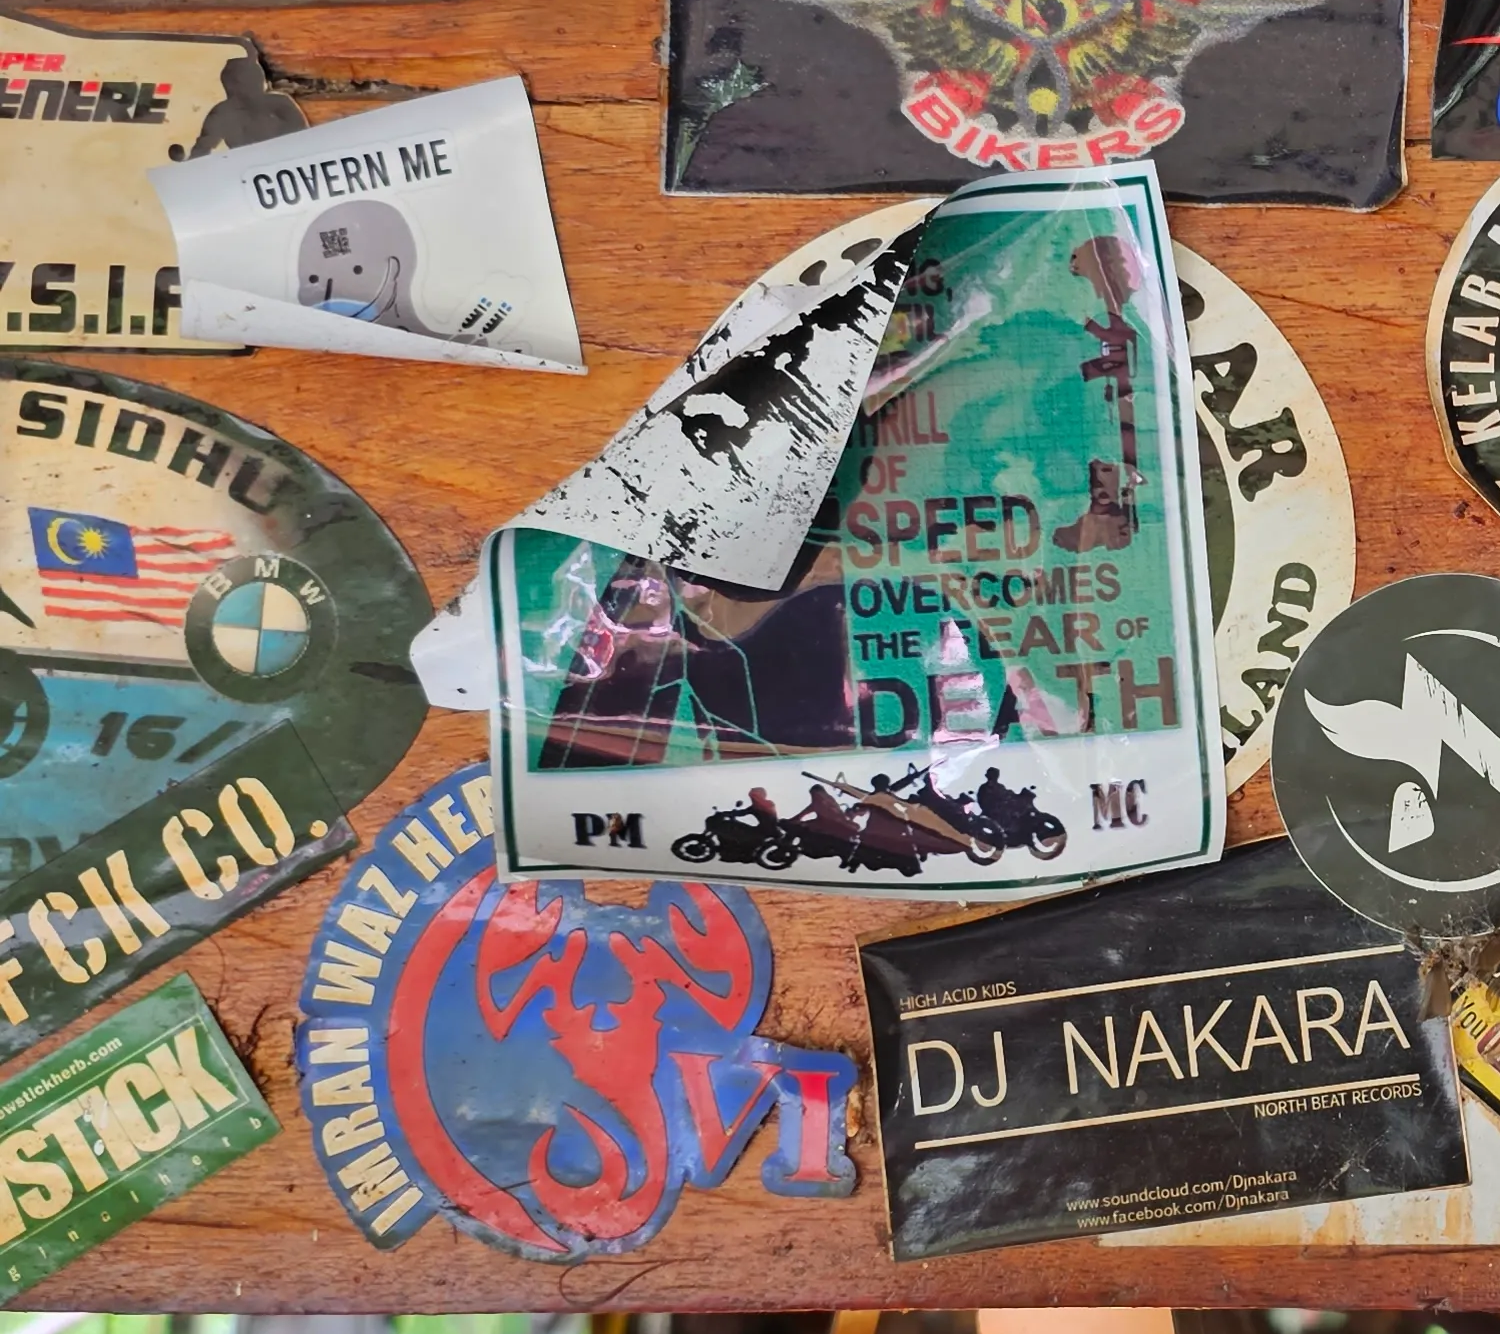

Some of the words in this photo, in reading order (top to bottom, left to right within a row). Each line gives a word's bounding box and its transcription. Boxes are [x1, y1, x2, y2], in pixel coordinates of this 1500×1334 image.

[0, 52, 66, 73] PER
[908, 95, 1183, 169] BIKERS
[253, 149, 391, 211] GOVERN
[398, 138, 453, 181] ME
[848, 390, 949, 447] HRILL
[860, 455, 907, 494] OF
[845, 494, 1041, 569] SPEED
[850, 563, 1121, 617] OVERCOMES
[853, 631, 922, 661] THE
[940, 612, 1105, 660] FEAR
[1115, 618, 1149, 641] OF
[856, 656, 1178, 749] DEATH
[573, 811, 647, 851] PM
[1090, 777, 1149, 833] MC
[162, 776, 329, 901] CO.
[313, 863, 418, 1007] WAZ
[899, 991, 938, 1013] HIGH
[943, 985, 978, 1006] ACID
[981, 980, 1017, 1001] KIDS
[907, 1030, 1008, 1117] DJ
[1062, 978, 1412, 1096] NAKARA
[1253, 1096, 1308, 1120] NORTH
[1311, 1091, 1349, 1114] BEAT
[1352, 1082, 1424, 1109] RECORDS
[311, 1025, 425, 1237] IMRAN
